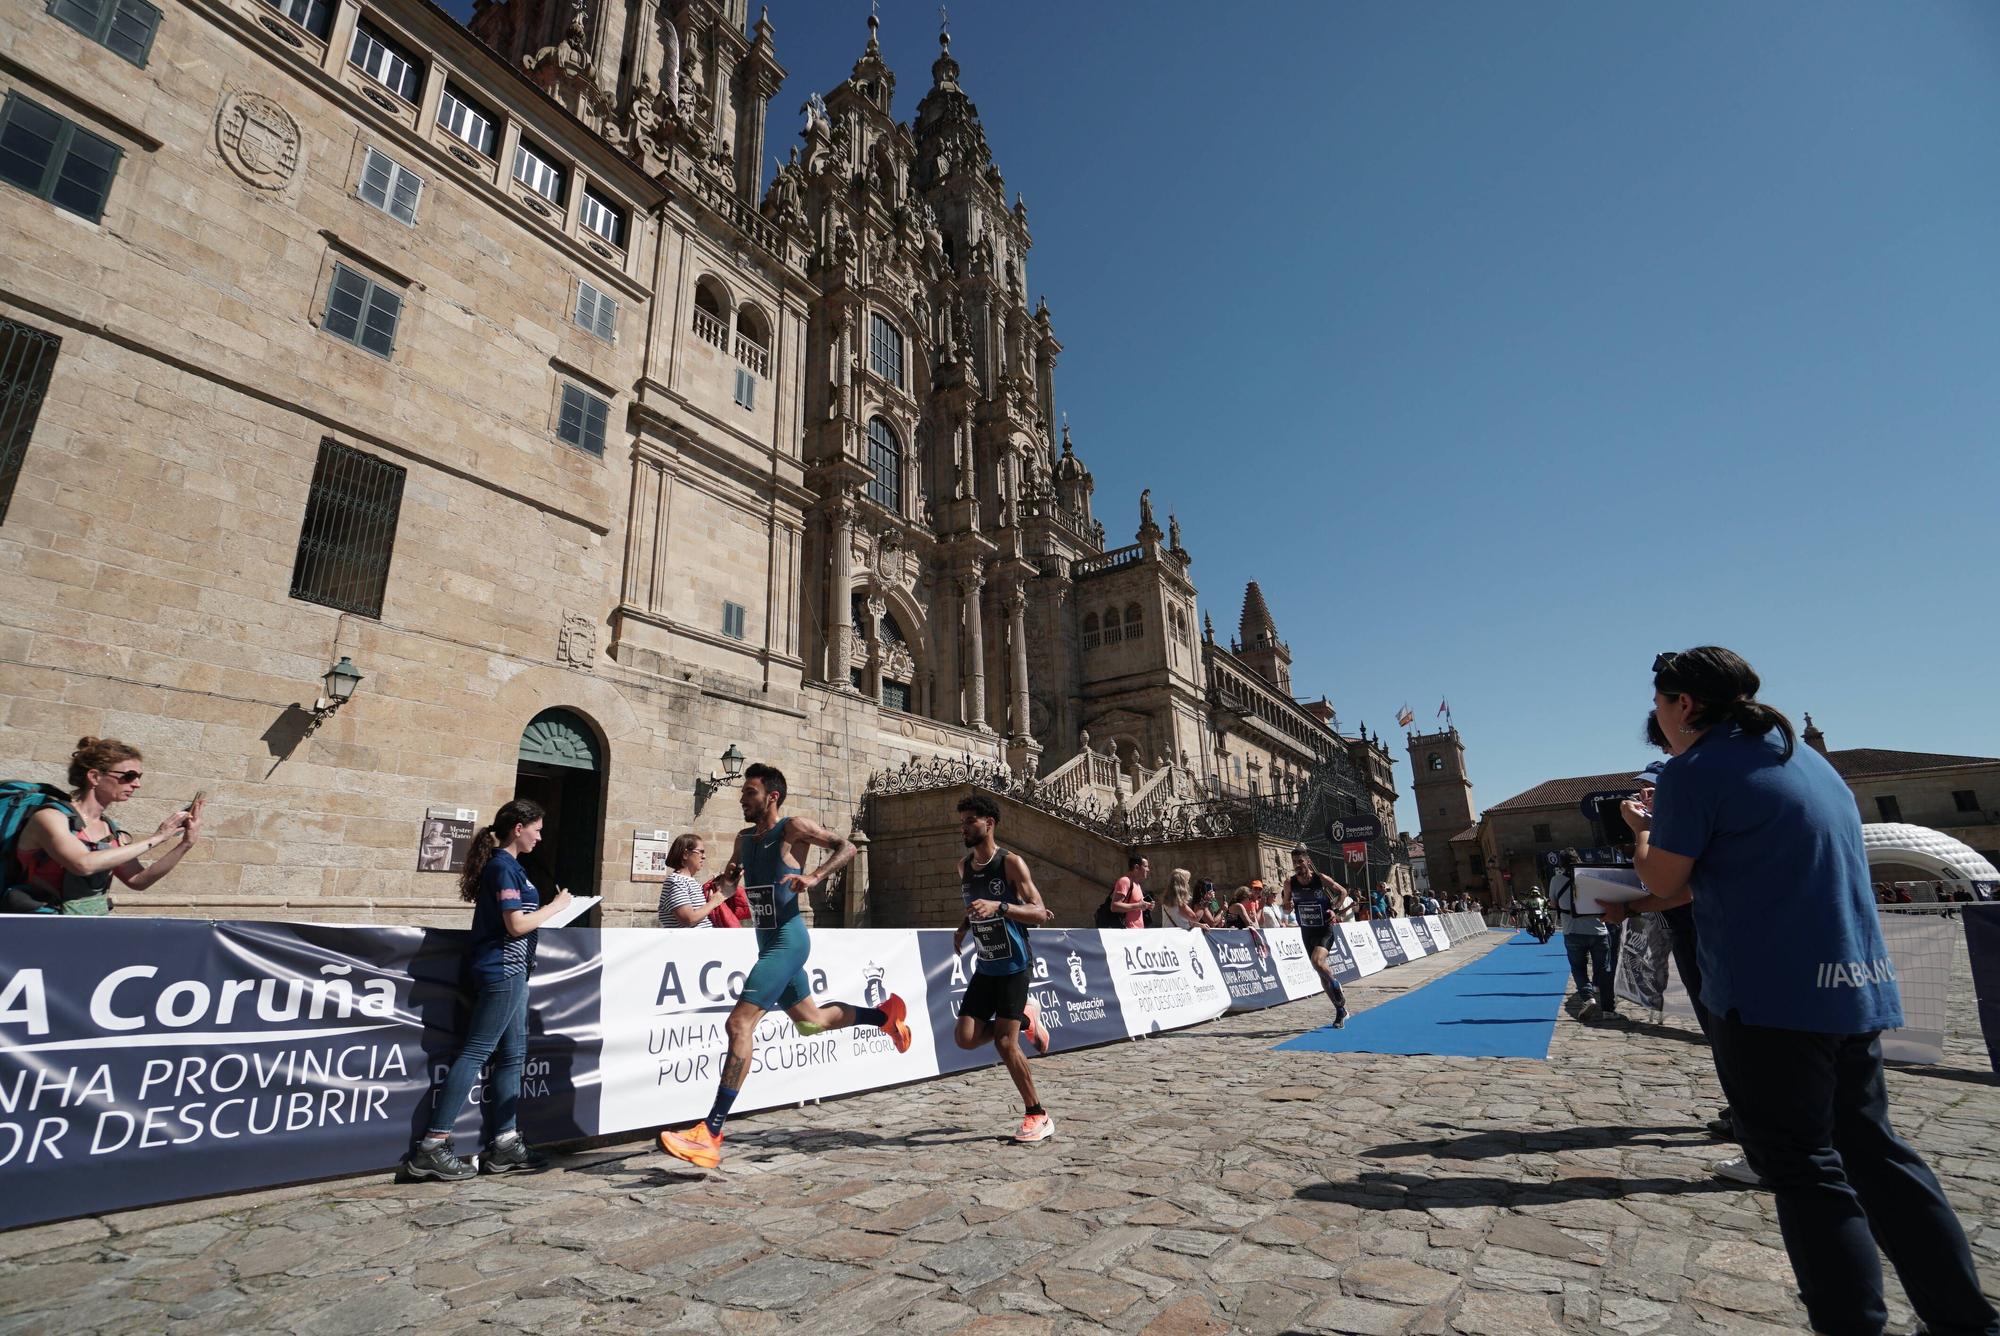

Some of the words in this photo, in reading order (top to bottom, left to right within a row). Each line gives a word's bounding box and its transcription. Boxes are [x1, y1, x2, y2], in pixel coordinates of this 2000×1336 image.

[1346, 850, 1364, 862] 75M
[1124, 946, 1136, 970] A
[0, 968, 50, 1035] A
[90, 964, 397, 1031] Coruña
[656, 961, 687, 1006] A
[699, 960, 828, 1002] Coa
[1067, 998, 1105, 1013] Deputación
[138, 1043, 408, 1100] PROVINCIA
[90, 1085, 389, 1155] DESCUBRIR
